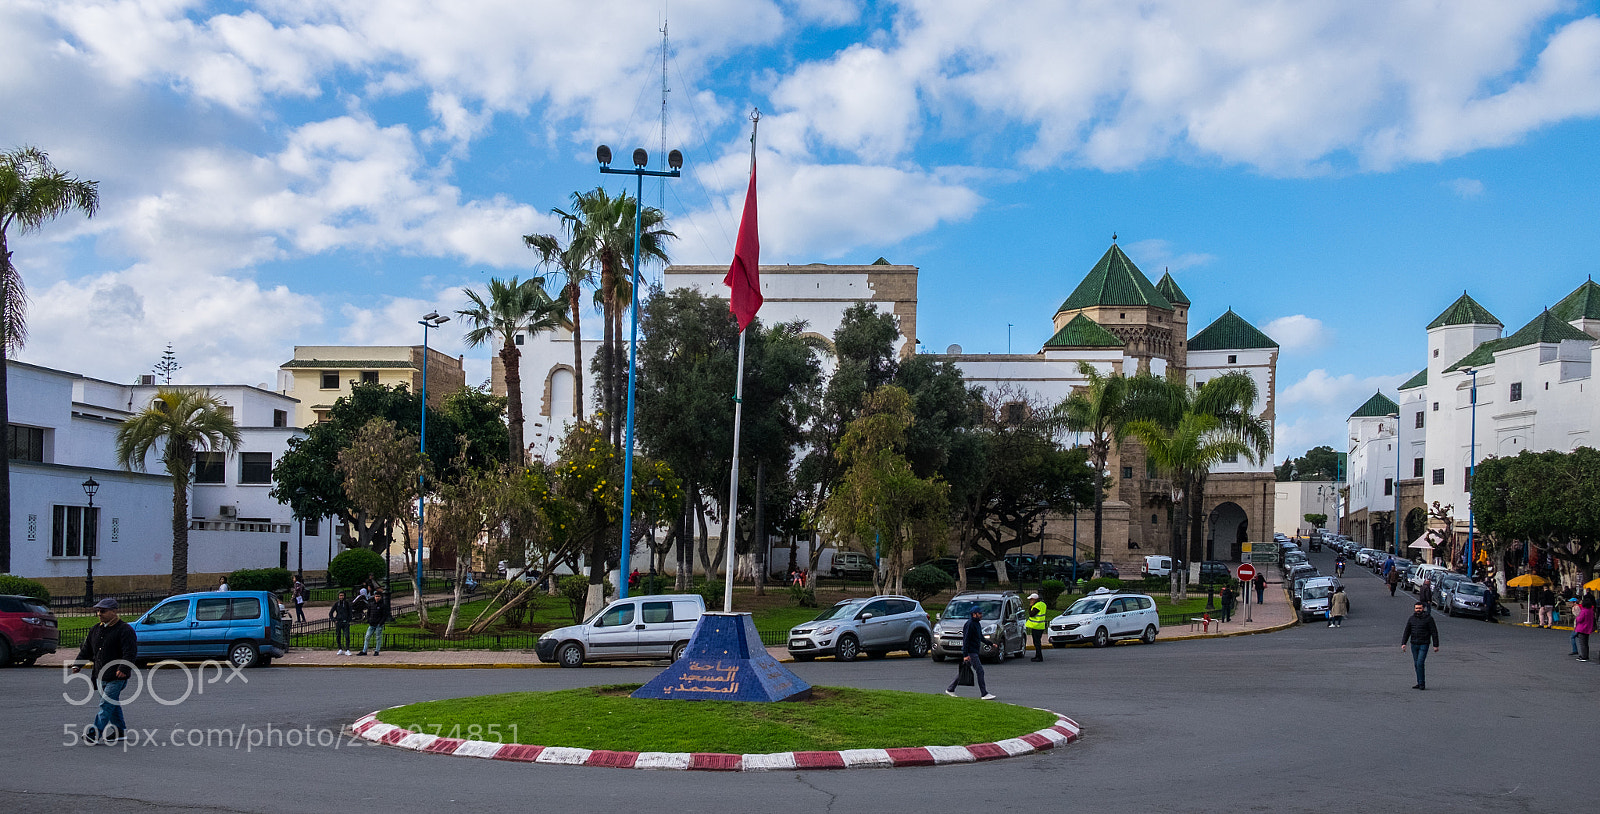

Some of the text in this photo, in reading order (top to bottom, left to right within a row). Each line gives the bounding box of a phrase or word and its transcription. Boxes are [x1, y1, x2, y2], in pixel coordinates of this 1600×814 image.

[689, 660, 739, 672] ساحة
[678, 671, 736, 684] المسجد
[663, 682, 740, 694] المحمدي
